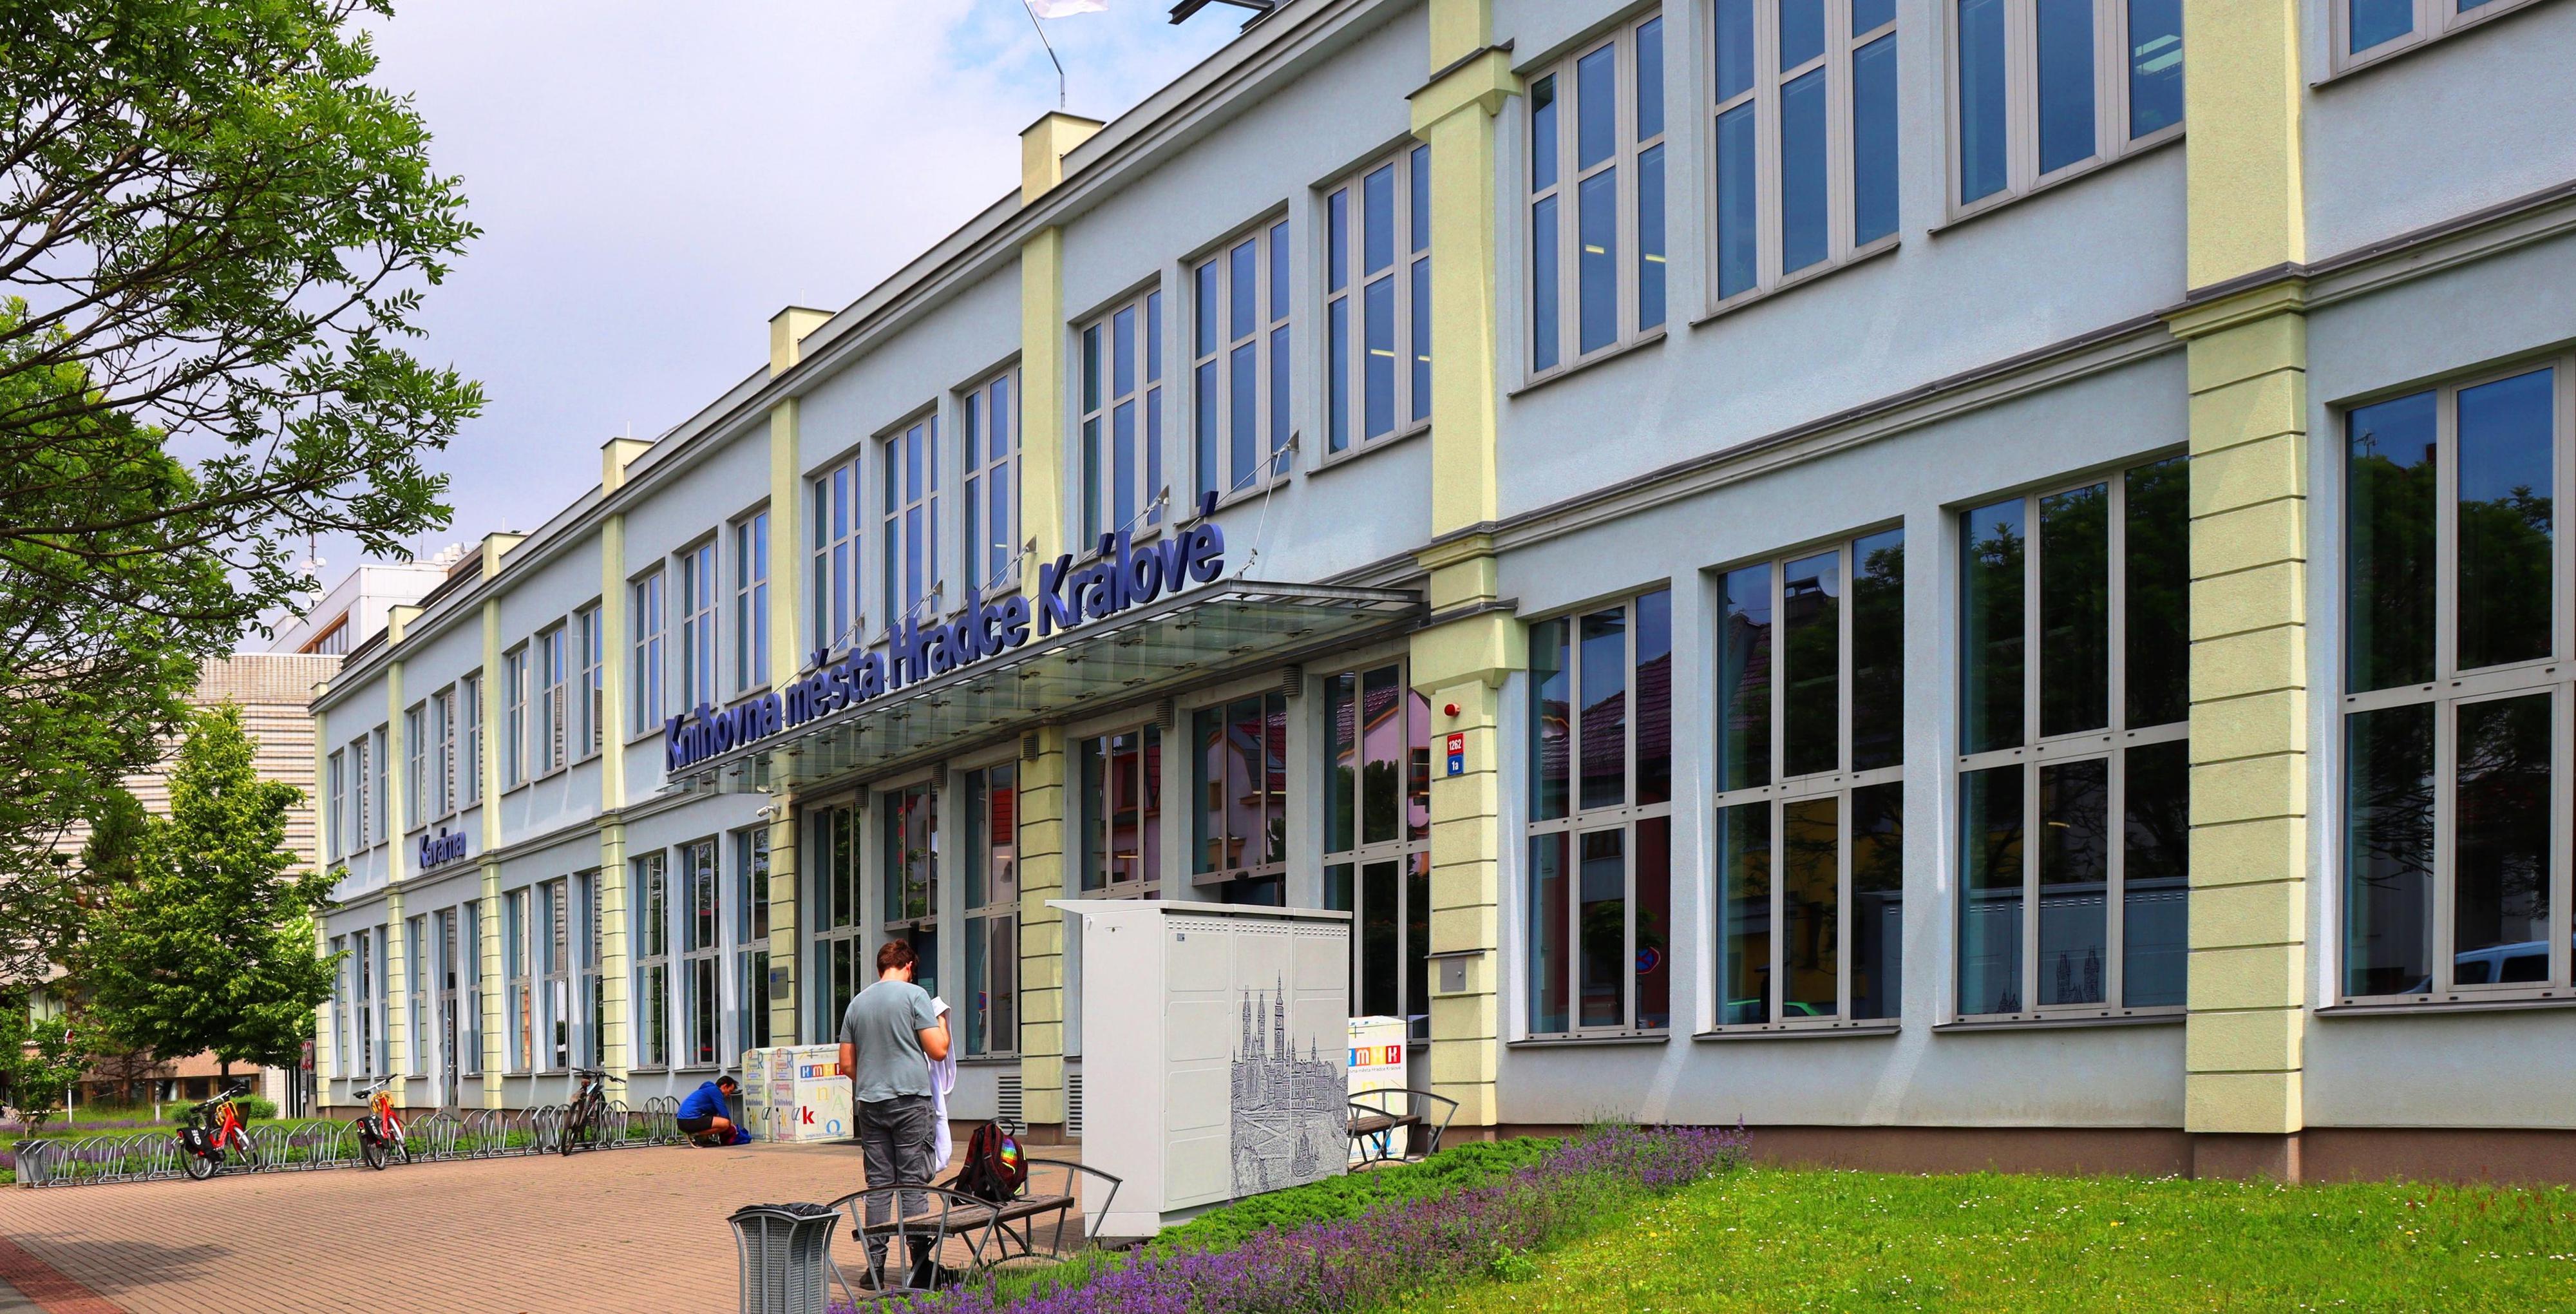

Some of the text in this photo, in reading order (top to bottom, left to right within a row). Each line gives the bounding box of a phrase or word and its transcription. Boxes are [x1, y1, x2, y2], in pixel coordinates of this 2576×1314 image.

[665, 490, 1225, 772] Knihovna města Hradce Králové
[1449, 739, 1462, 751] 1262
[1452, 761, 1459, 770] 1a
[419, 827, 466, 869] Kavárna
